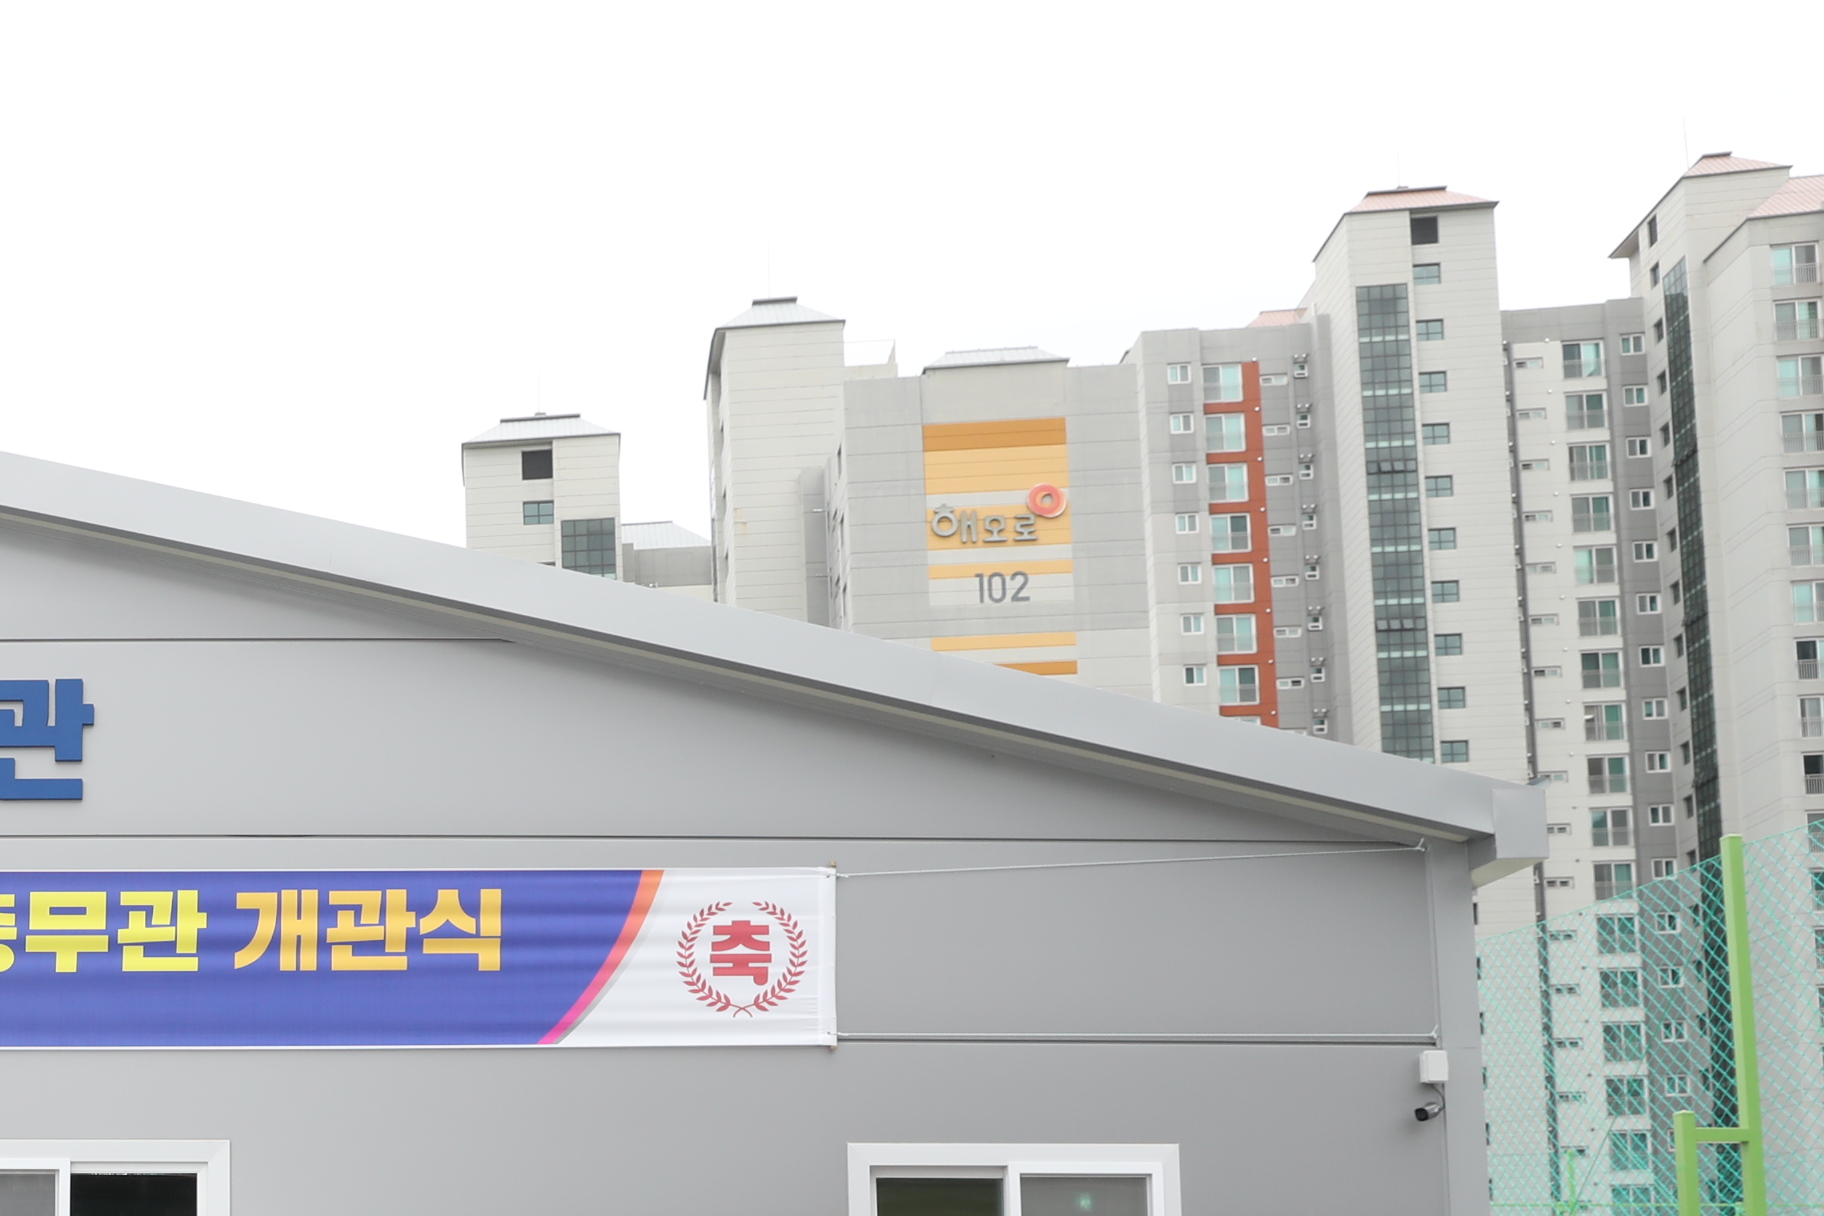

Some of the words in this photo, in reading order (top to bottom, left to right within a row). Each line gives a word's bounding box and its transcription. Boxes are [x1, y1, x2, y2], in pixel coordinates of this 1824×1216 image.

[975, 570, 1031, 604] 102
[234, 888, 502, 972] 개관식
[710, 921, 776, 986] 축
